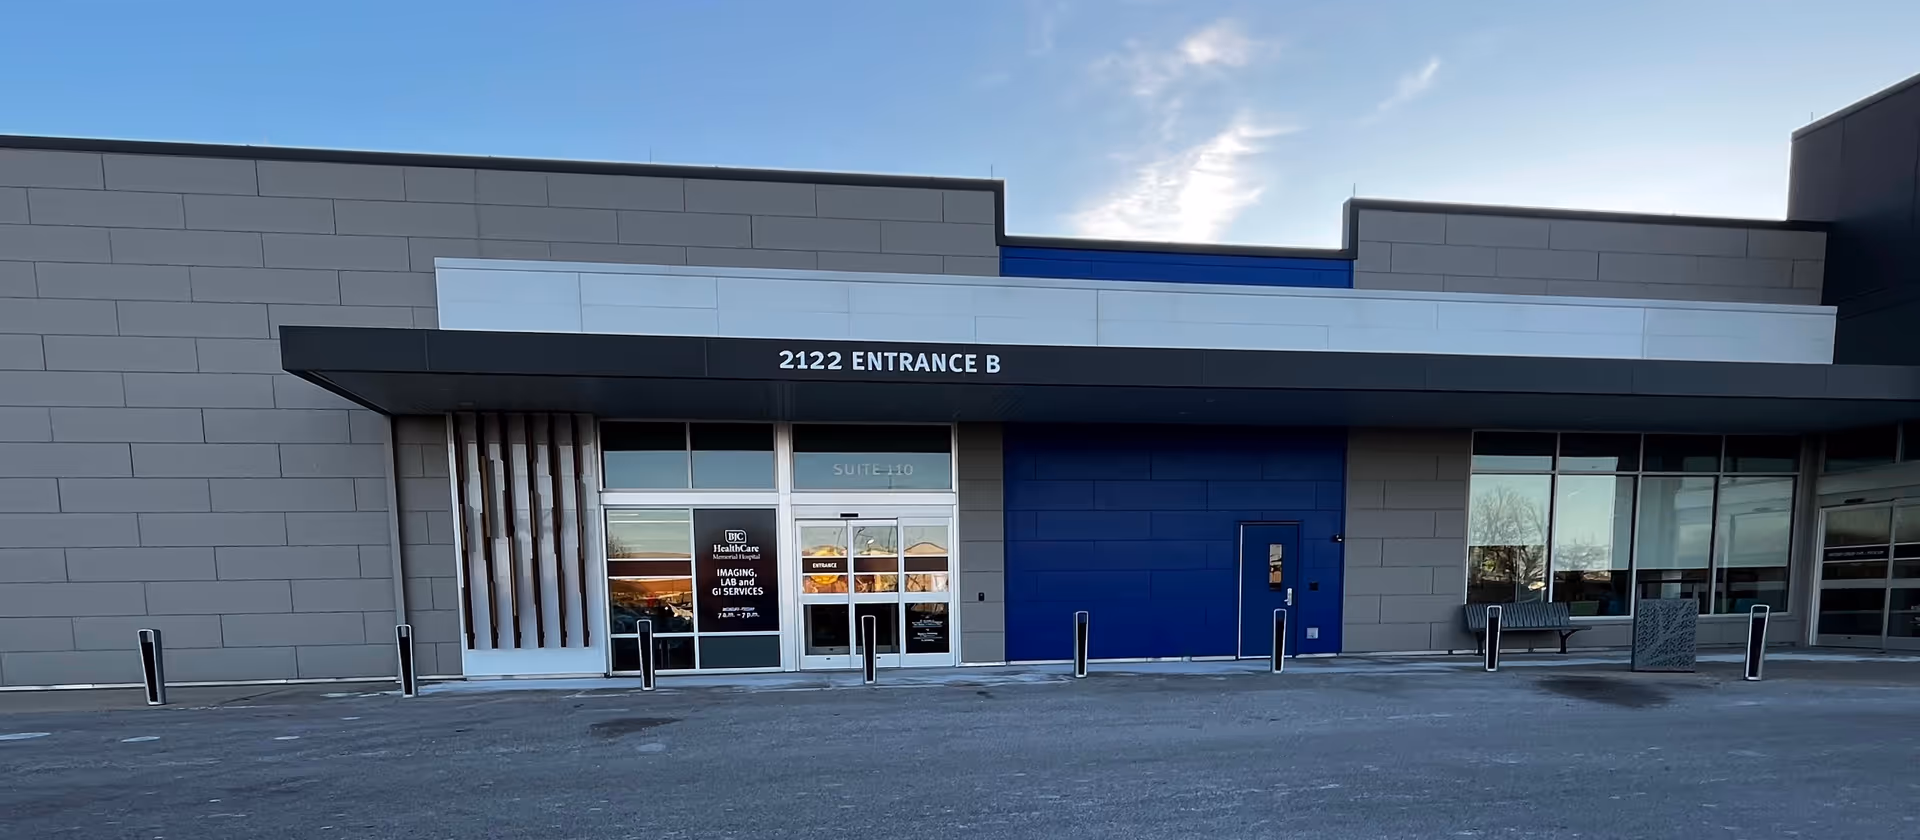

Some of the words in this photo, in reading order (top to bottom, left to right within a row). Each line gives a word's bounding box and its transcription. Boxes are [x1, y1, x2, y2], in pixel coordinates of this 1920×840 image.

[779, 350, 843, 370] 2122
[852, 351, 978, 373] ENTRANCE
[986, 354, 1001, 373] B
[832, 463, 881, 476] SUITE
[887, 463, 914, 476] 110
[728, 532, 744, 542] BJC
[713, 544, 760, 553] HealthCare
[716, 568, 758, 578] IMAGING,
[720, 578, 737, 587] LAB
[738, 578, 755, 587] and
[712, 587, 722, 596] GI
[723, 587, 764, 596] SERVICES
